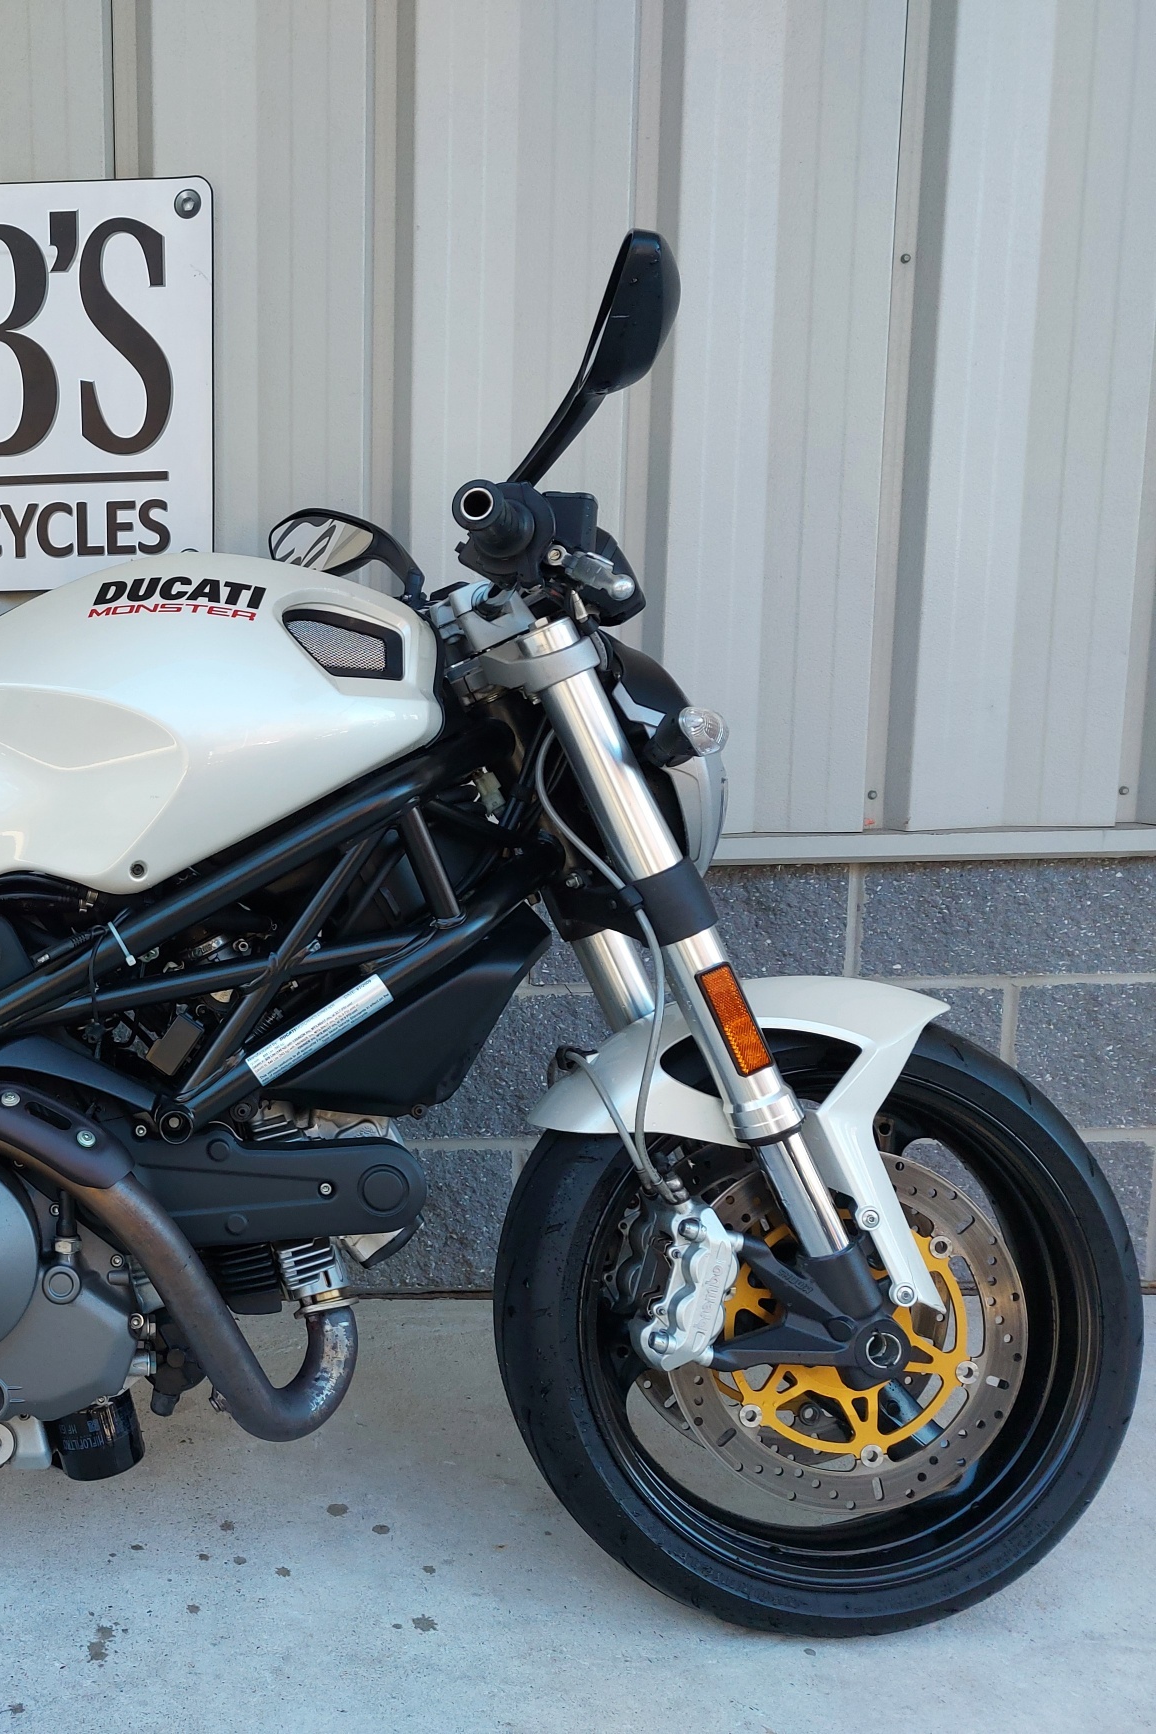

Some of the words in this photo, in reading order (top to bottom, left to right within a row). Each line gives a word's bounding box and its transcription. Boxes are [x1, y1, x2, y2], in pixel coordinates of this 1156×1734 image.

[93, 576, 267, 609] DUCATI
[88, 603, 257, 621] MONSTER
[694, 1263, 724, 1332] brembo
